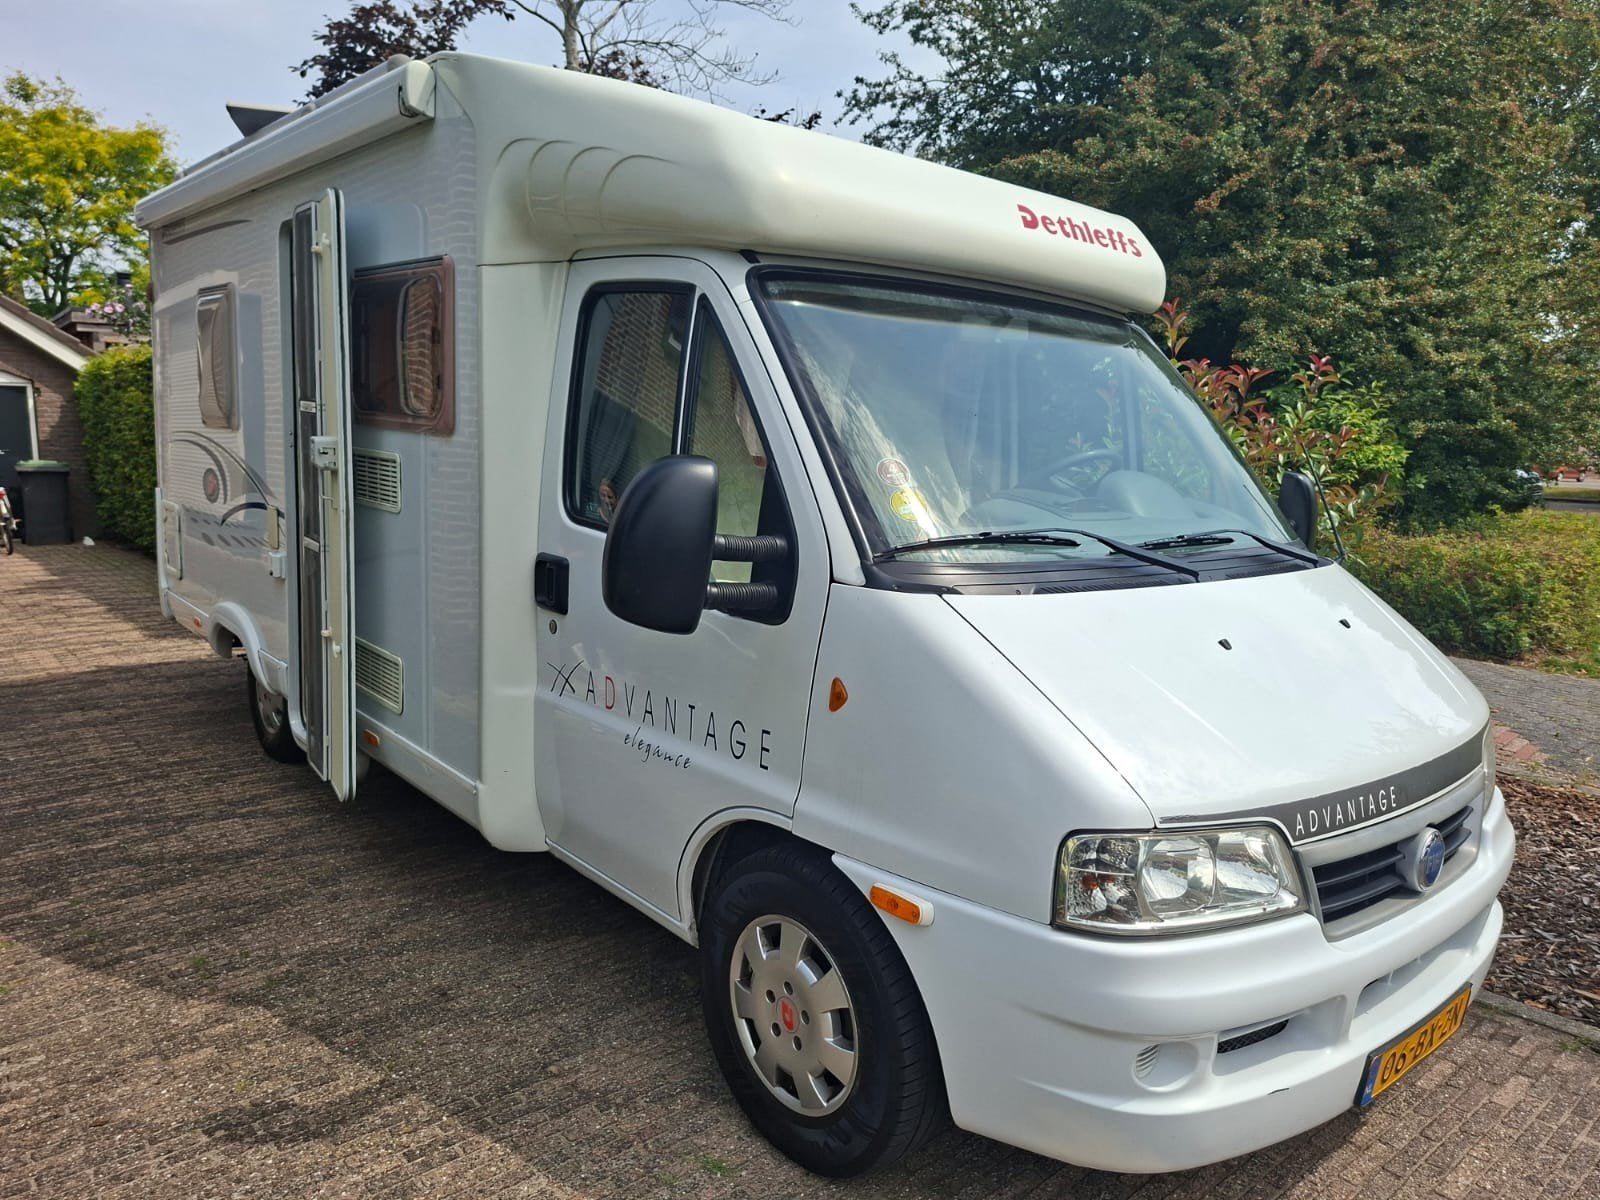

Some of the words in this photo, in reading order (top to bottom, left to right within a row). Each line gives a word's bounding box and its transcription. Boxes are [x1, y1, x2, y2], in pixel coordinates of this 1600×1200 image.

[1016, 203, 1142, 257] Dethleffs
[585, 670, 771, 770] ADVANTAGE
[623, 726, 692, 769] elegance
[1295, 786, 1397, 836] ADVANTAGE
